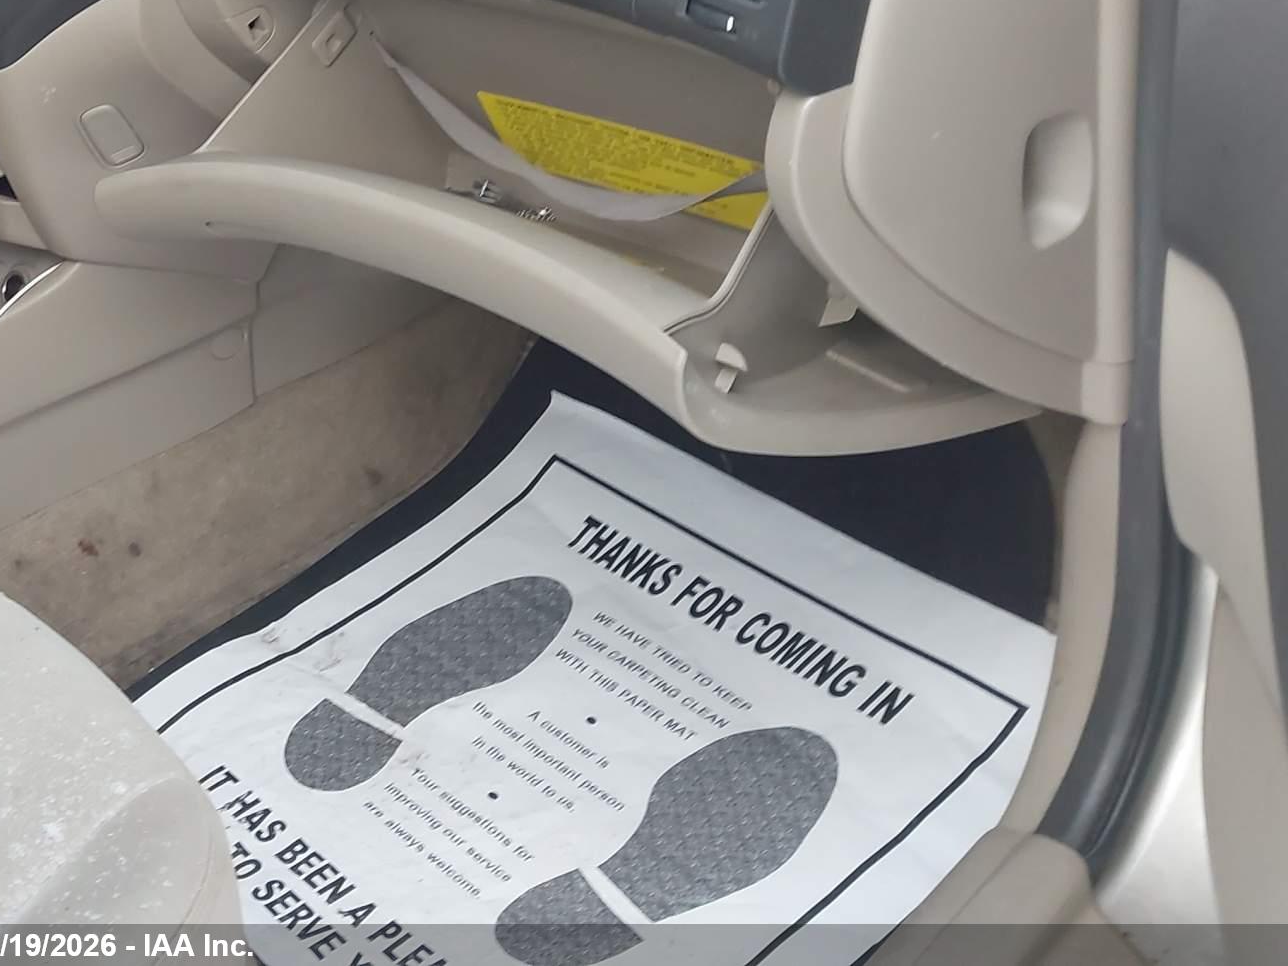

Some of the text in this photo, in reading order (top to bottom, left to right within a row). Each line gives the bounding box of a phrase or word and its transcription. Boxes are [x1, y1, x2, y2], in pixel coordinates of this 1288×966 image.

[567, 515, 914, 725] THANKS FOR COMING IN
[593, 611, 752, 711] WE HAVE TRIED TO KEEP
[555, 648, 699, 740] WITH THIS PAPER MAT
[571, 628, 731, 729] YOUR CARPETING CLEAN
[198, 765, 239, 793] IT
[472, 701, 625, 812] the most important person
[472, 735, 486, 749] in
[486, 746, 505, 762] the
[507, 761, 544, 787] world
[542, 785, 557, 798] to
[528, 710, 610, 769] A customer is
[217, 790, 287, 843] HAS
[363, 801, 384, 818] are
[384, 819, 425, 852] always
[384, 782, 512, 882] improving our service
[412, 767, 535, 862] Your suggestions for
[274, 837, 357, 905] BEEN
[251, 878, 347, 961] SERVE
[338, 902, 377, 929] A
